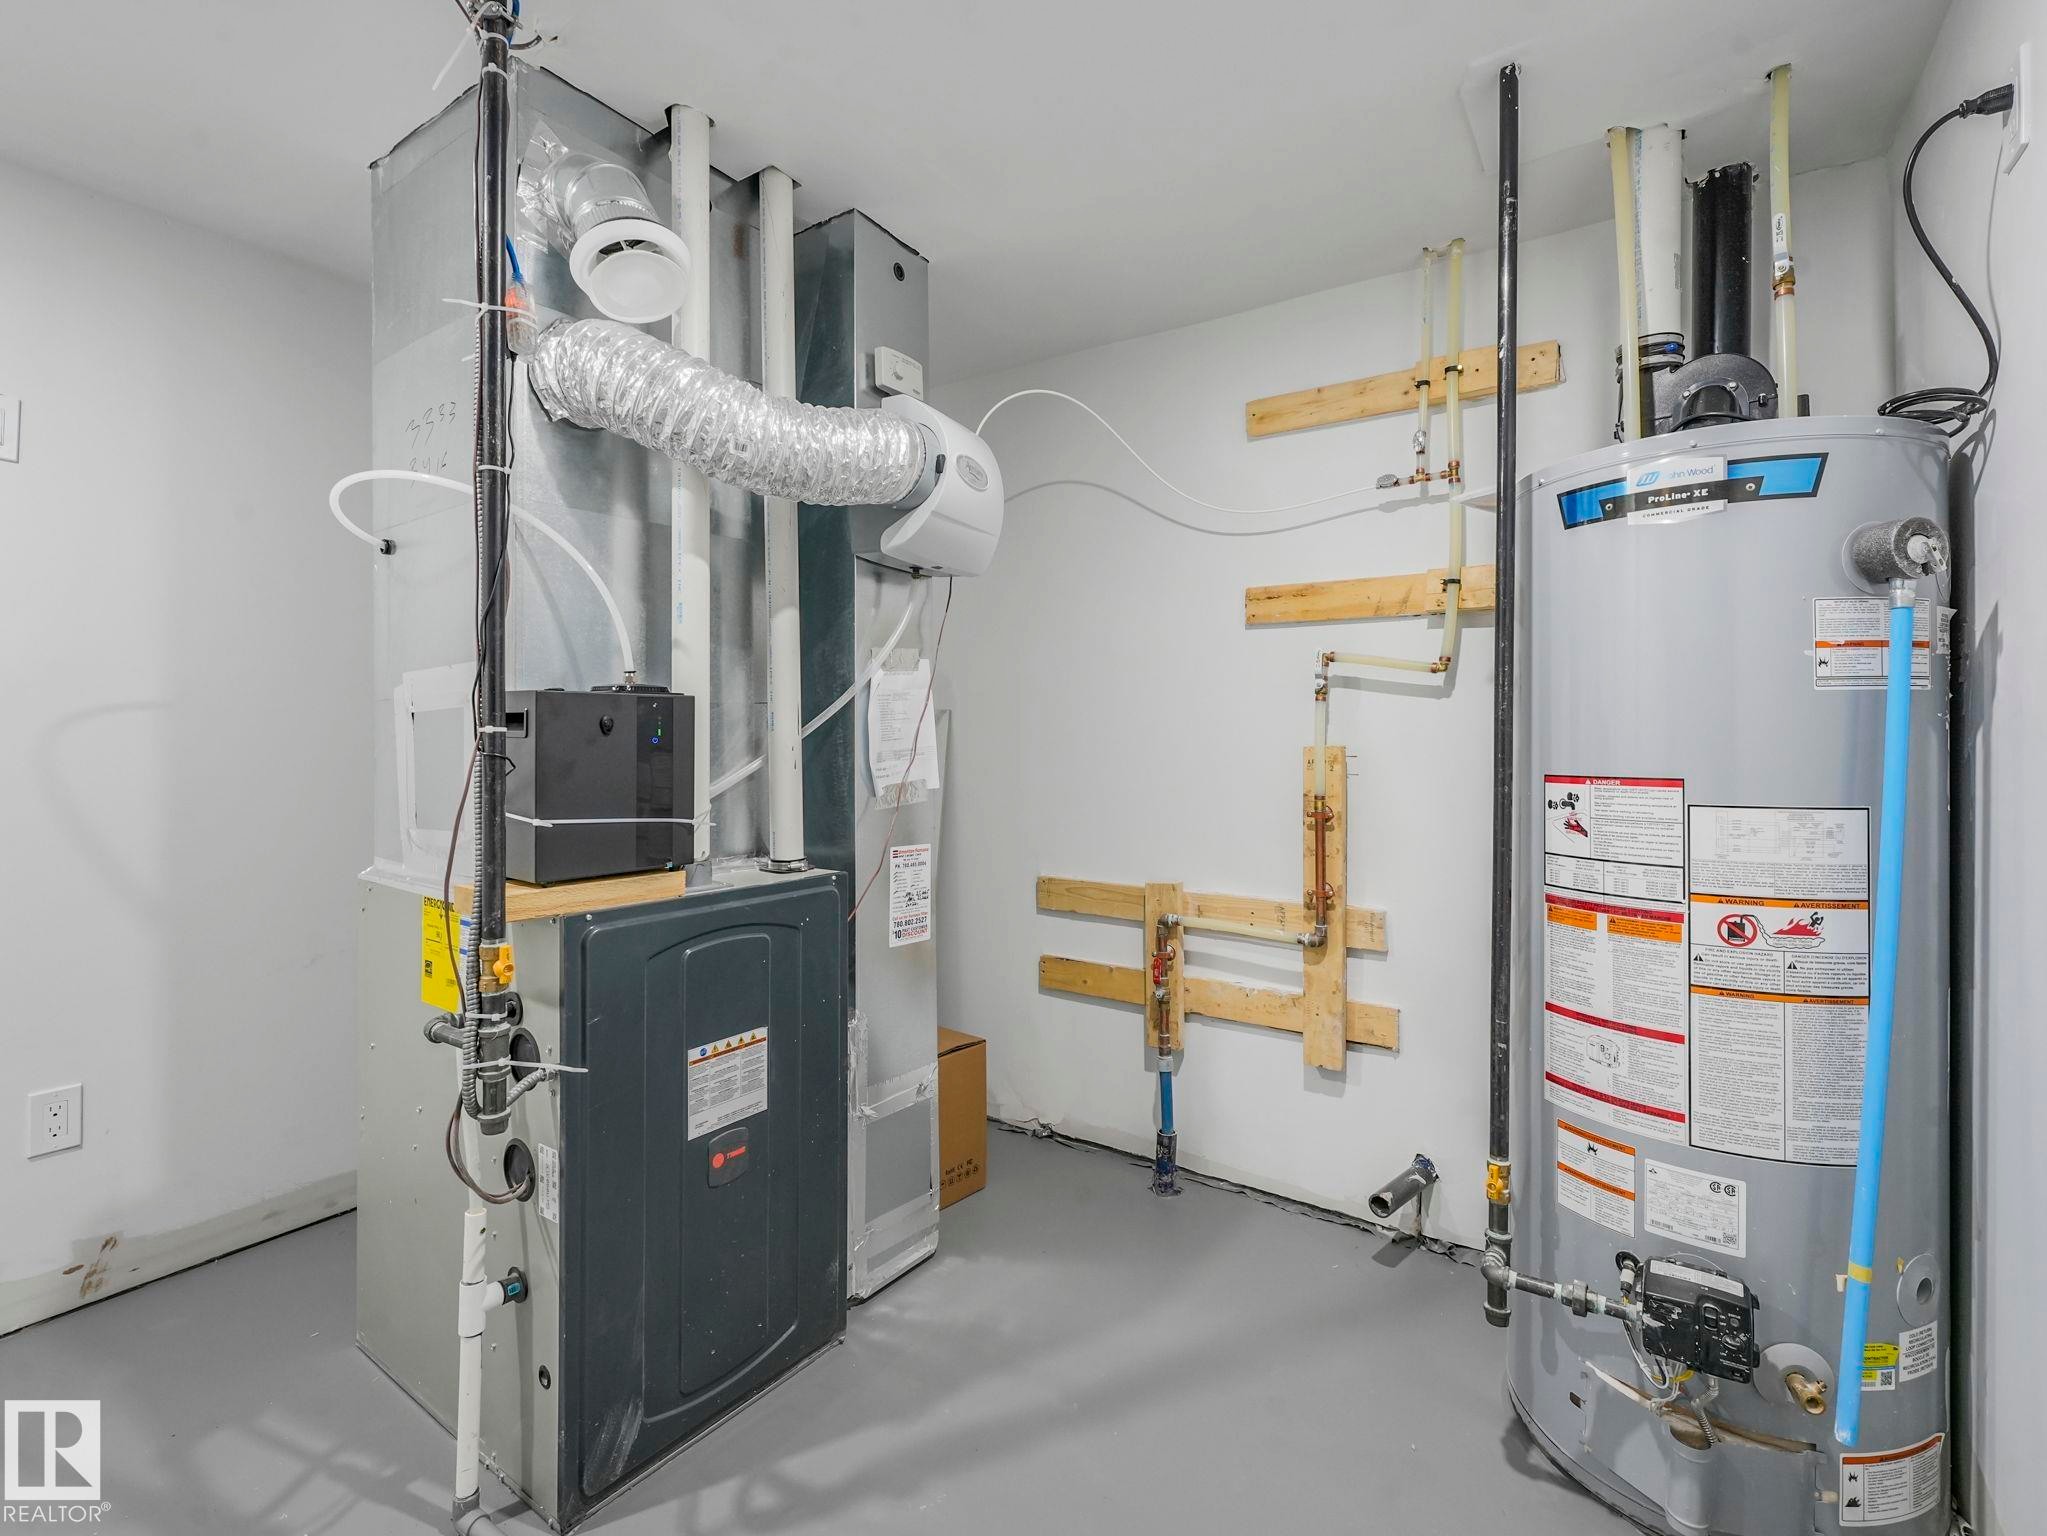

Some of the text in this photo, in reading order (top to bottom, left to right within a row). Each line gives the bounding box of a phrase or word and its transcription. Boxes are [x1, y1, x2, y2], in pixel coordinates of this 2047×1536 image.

[1687, 466, 1714, 476] Wood
[1648, 488, 1709, 503] ProLine XE
[1642, 509, 1683, 518] COMMERCIAL
